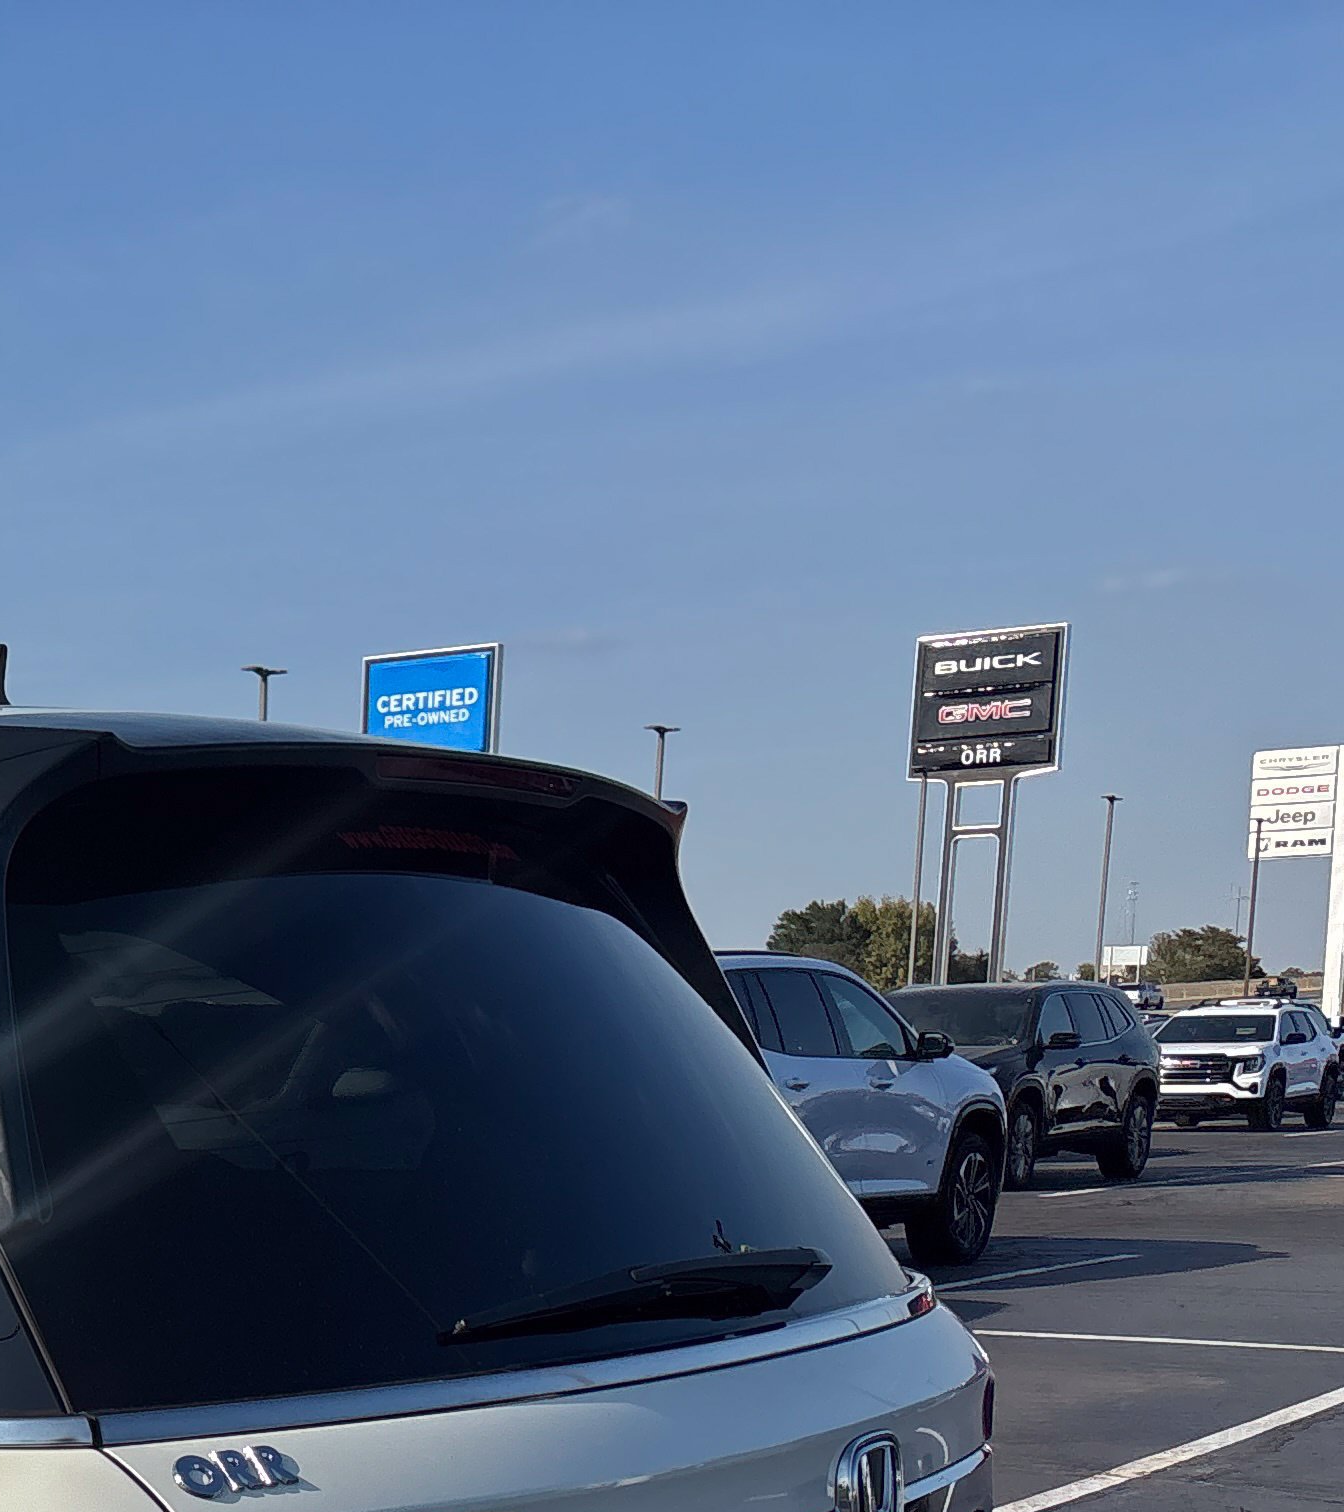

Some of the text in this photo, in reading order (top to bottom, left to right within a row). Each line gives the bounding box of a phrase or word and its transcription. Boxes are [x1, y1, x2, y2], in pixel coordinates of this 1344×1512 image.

[934, 651, 1042, 675] BUICK
[376, 687, 479, 714] CERTIFIED
[384, 708, 471, 729] PRE-OWNED
[938, 698, 1032, 724] GMC
[961, 748, 1001, 765] ORR
[1259, 754, 1330, 765] CHRYSLER
[1257, 784, 1330, 797] DODGE
[1266, 809, 1316, 825] Jeep
[1275, 838, 1327, 848] RAM
[173, 1446, 300, 1500] ORR
